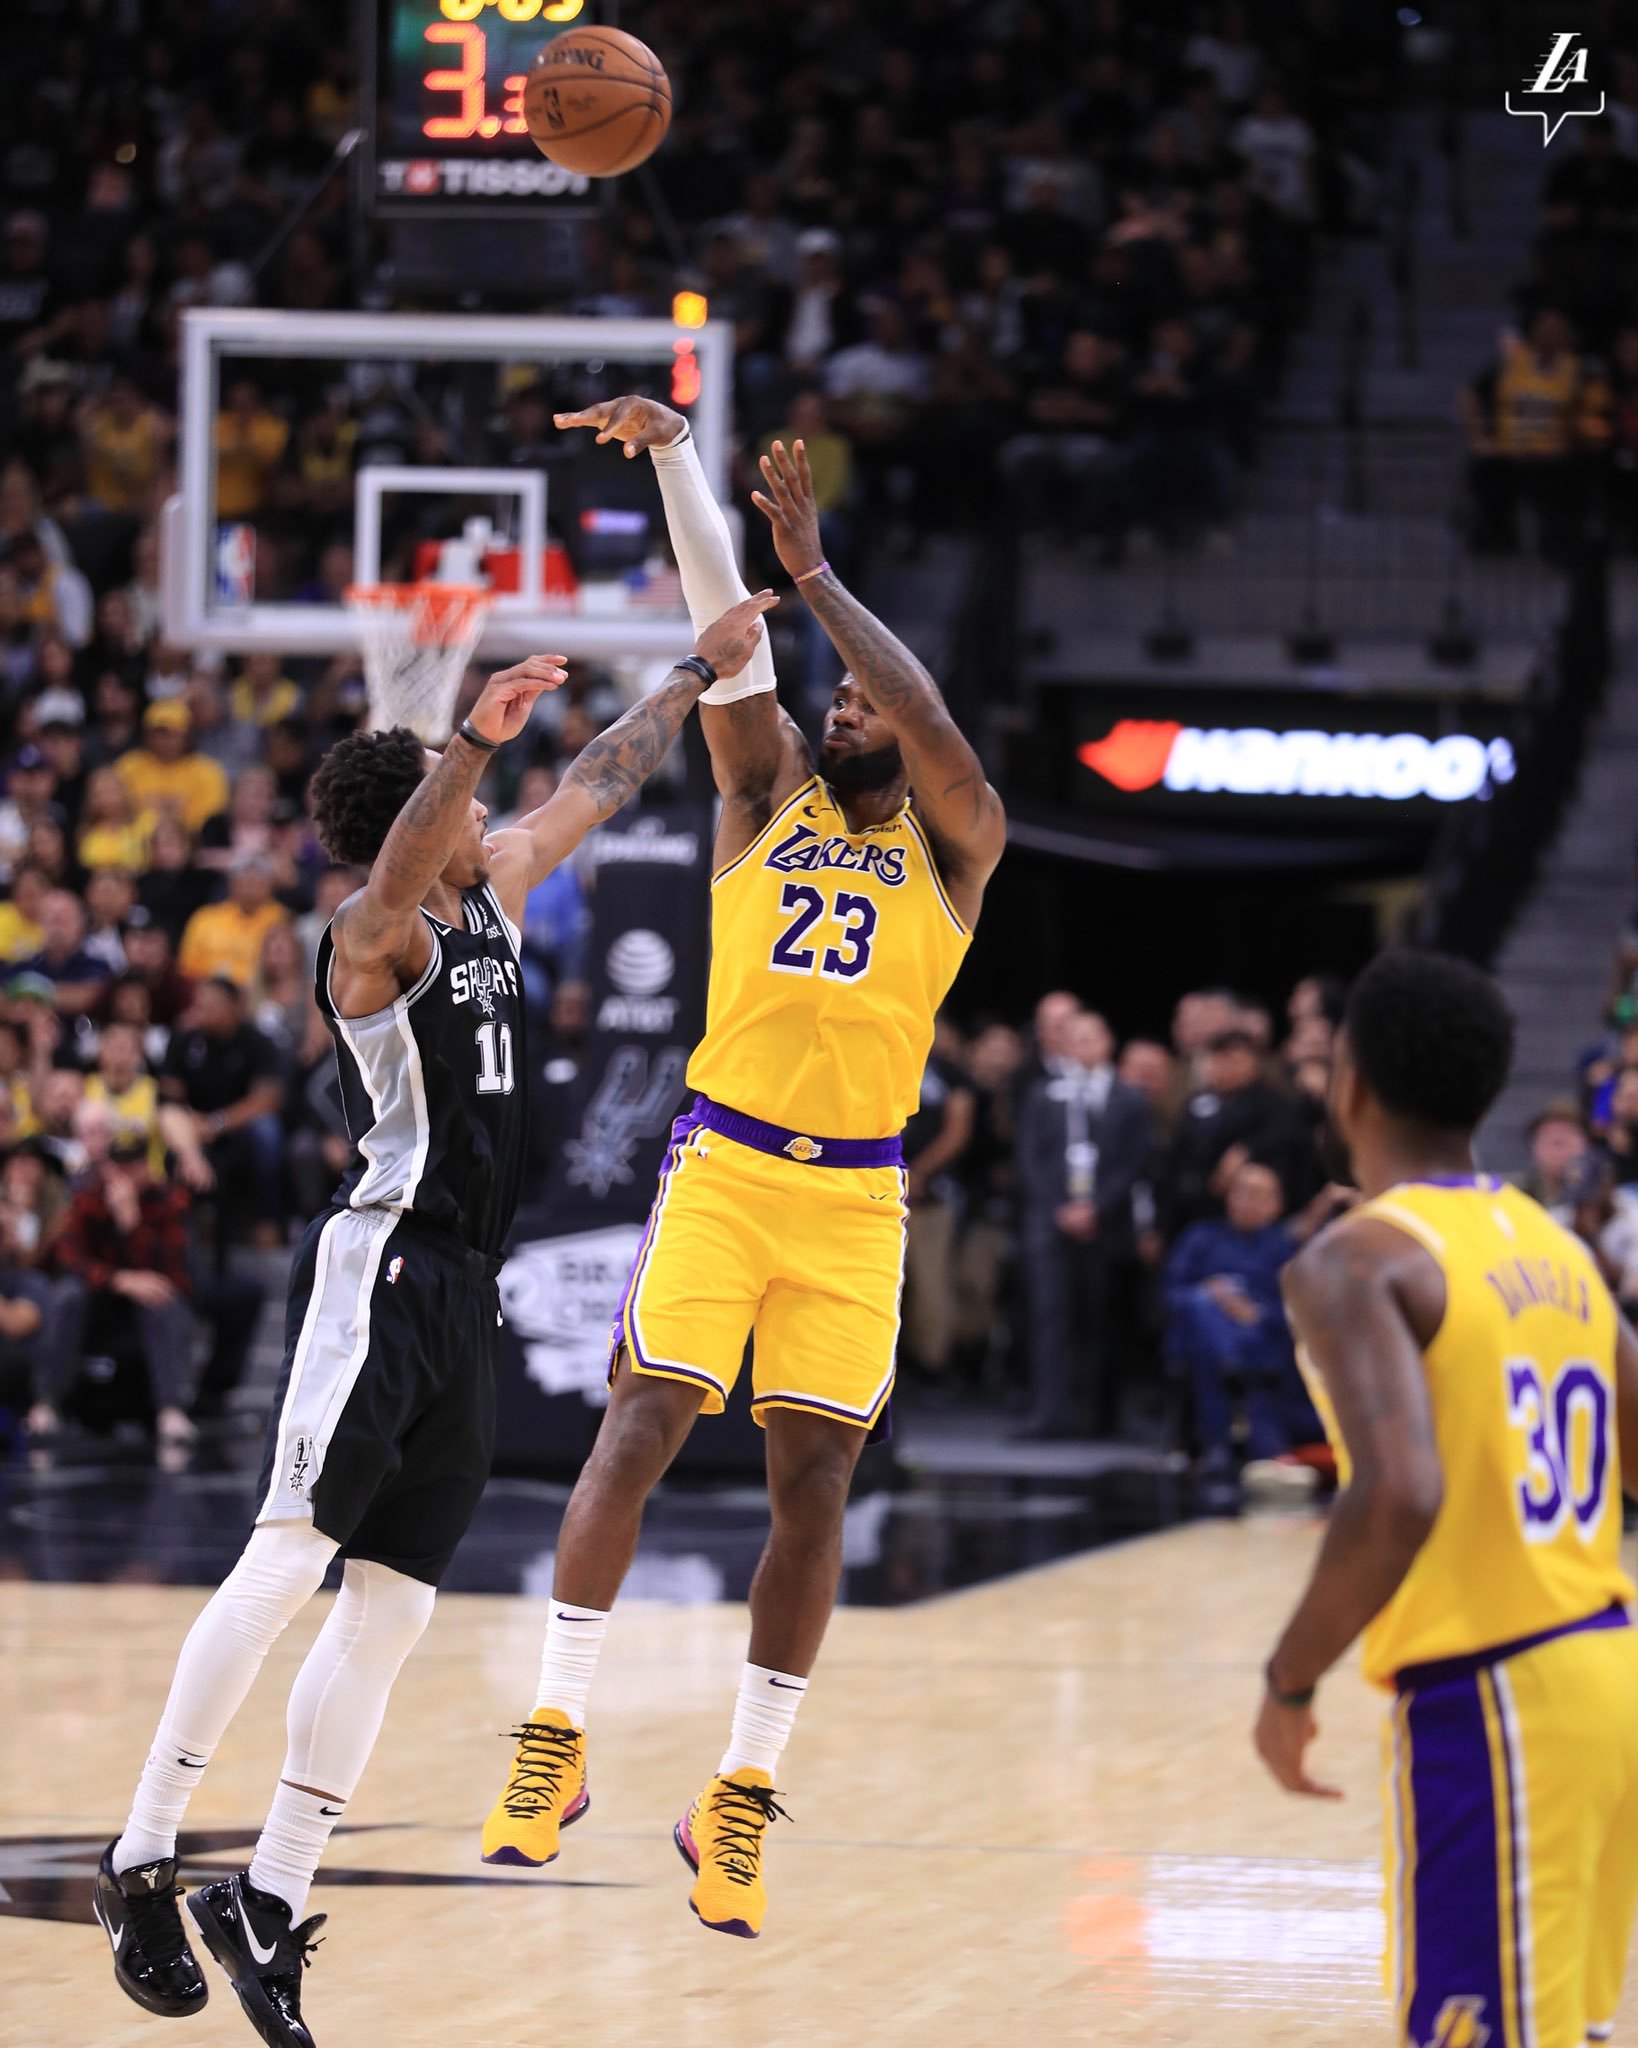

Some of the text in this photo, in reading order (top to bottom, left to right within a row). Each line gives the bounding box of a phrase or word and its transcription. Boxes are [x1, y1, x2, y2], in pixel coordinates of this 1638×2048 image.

[763, 823, 907, 888] LAKERS
[768, 879, 880, 985] 23
[475, 1020, 515, 1095] 10
[1504, 1357, 1616, 1546] 30
